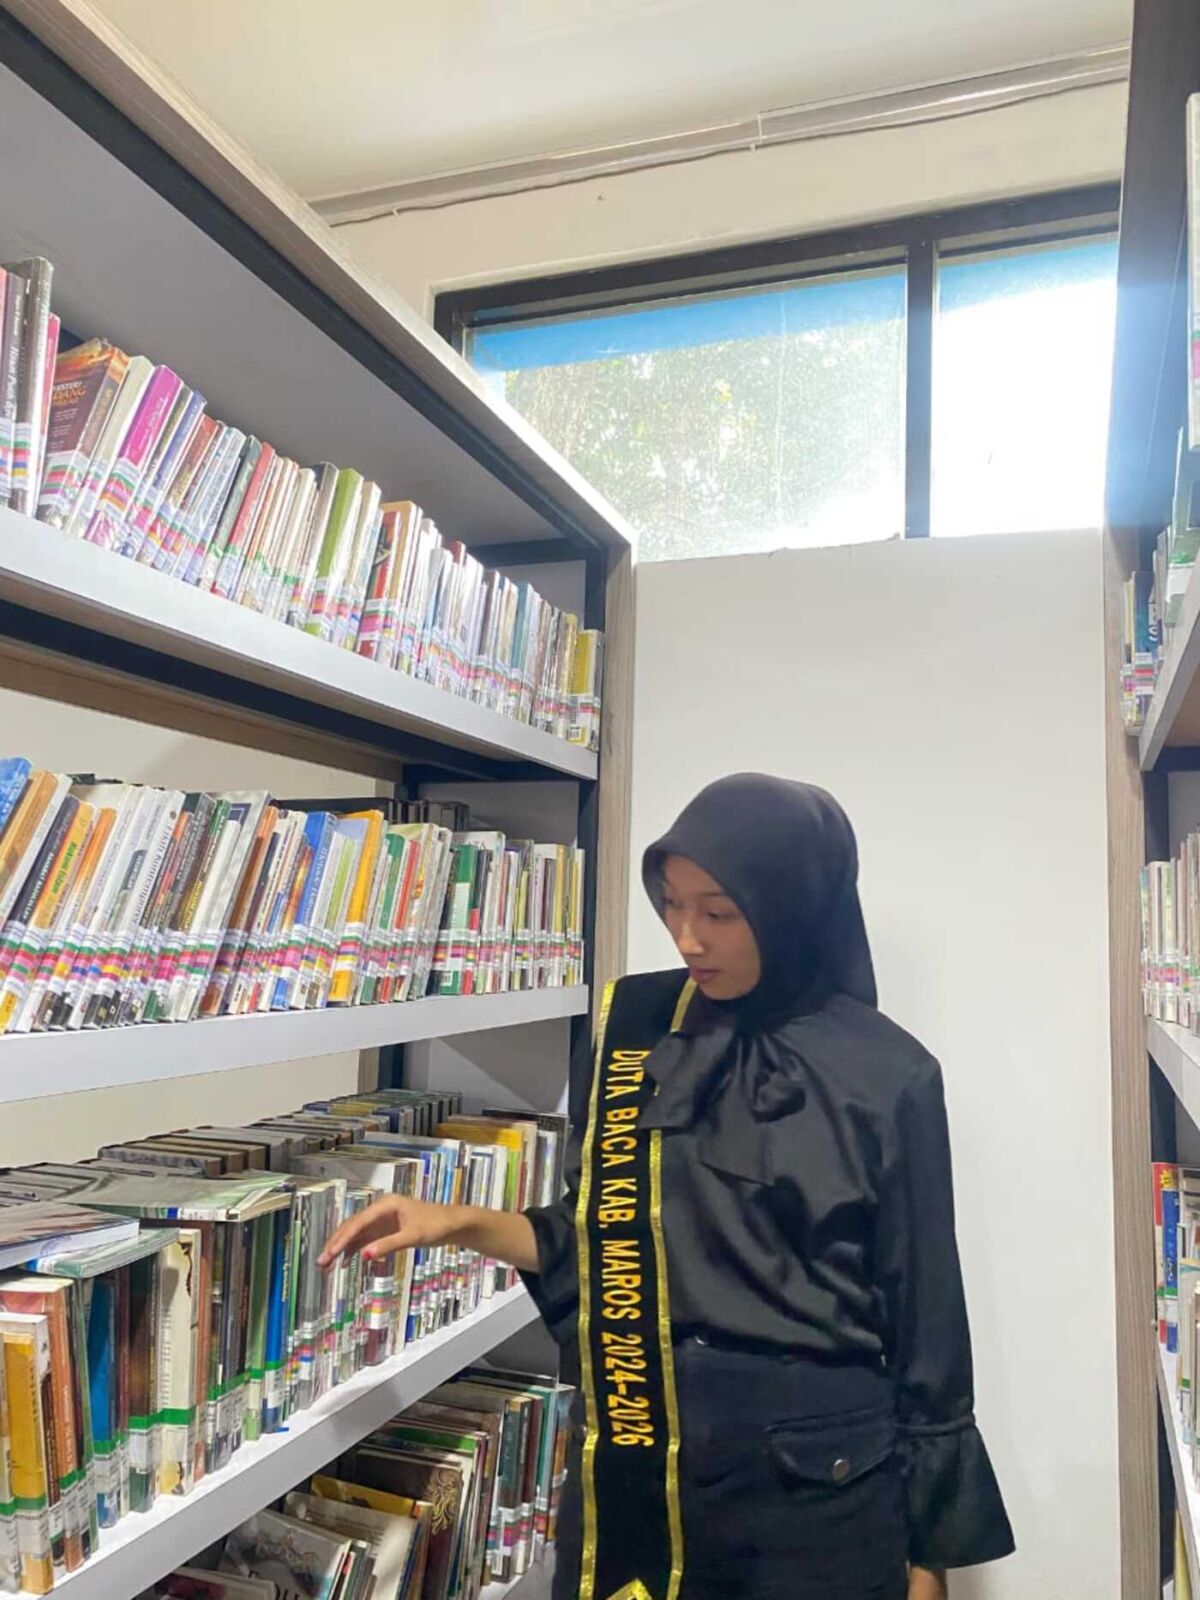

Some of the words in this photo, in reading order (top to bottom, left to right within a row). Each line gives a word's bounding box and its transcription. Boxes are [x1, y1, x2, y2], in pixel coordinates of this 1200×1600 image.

[604, 1050, 650, 1100] DUTA
[601, 1106, 639, 1168] BACA
[601, 1239, 642, 1320] MAROS
[601, 1331, 654, 1446] 2024-2026
